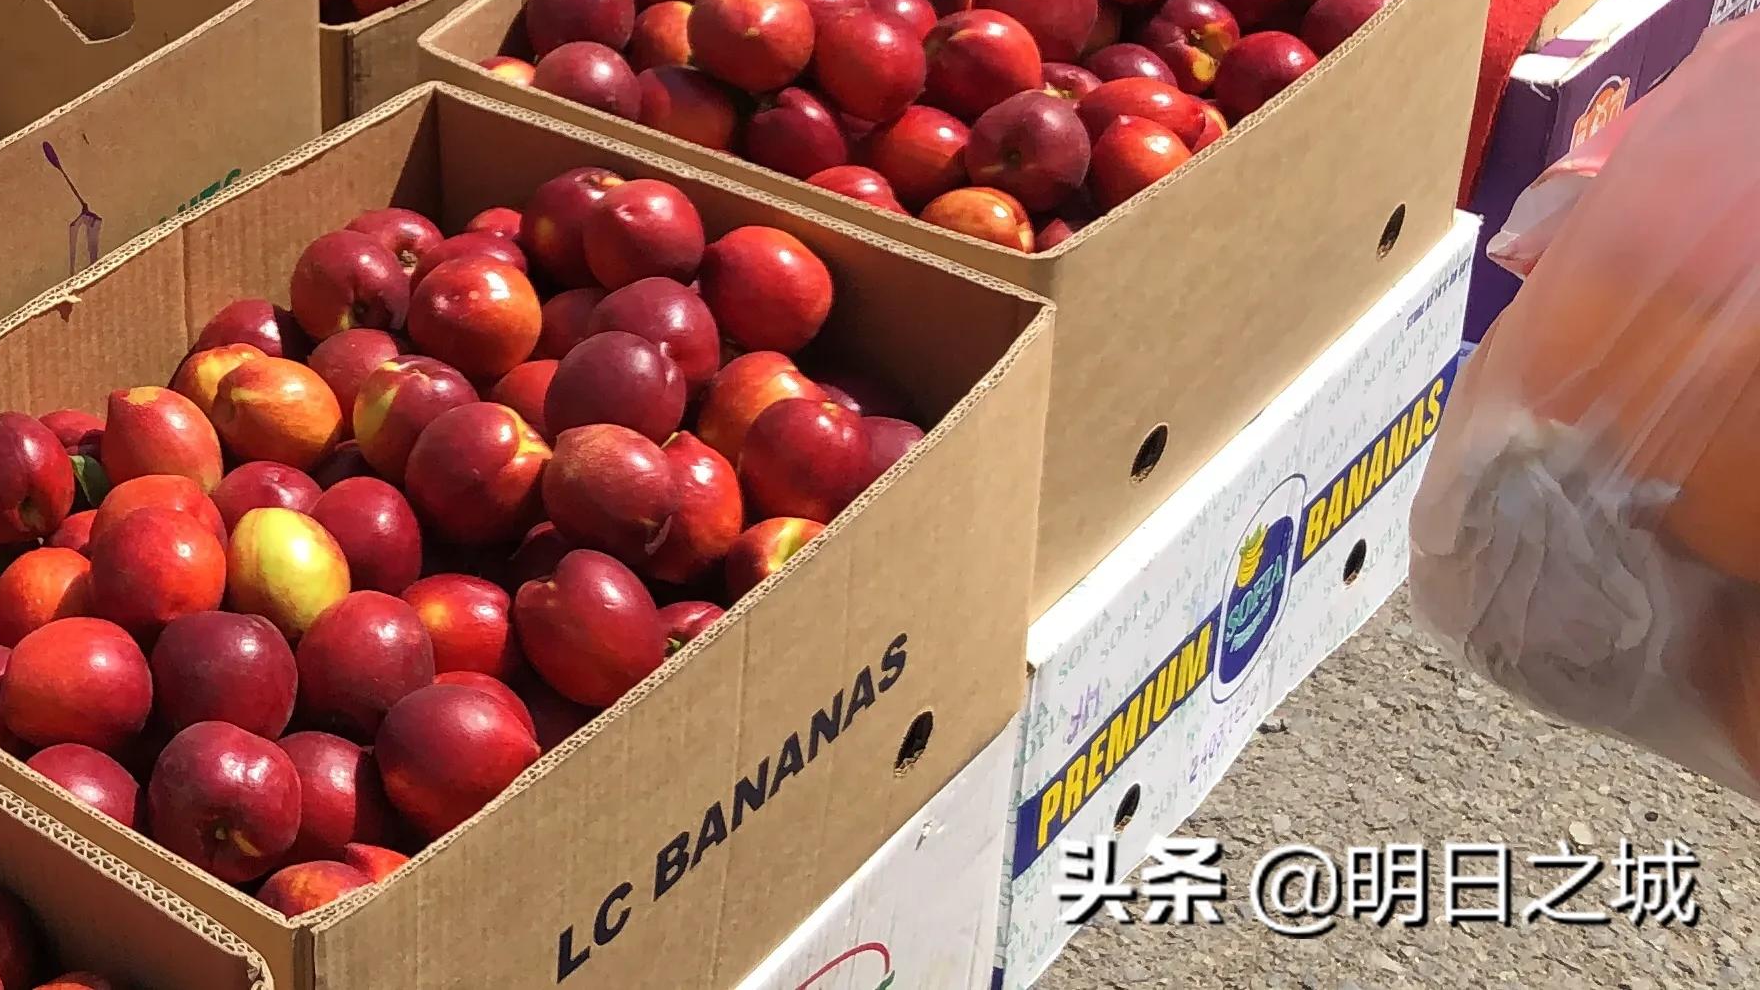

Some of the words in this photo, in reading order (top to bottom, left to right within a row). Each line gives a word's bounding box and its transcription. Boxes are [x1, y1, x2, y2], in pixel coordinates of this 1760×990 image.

[1037, 621, 1212, 851] PREMIUM
[1302, 377, 1444, 561] BANANAS
[1225, 554, 1284, 644] SOFIA
[556, 881, 633, 984] LC
[653, 632, 908, 901] BANANAS
